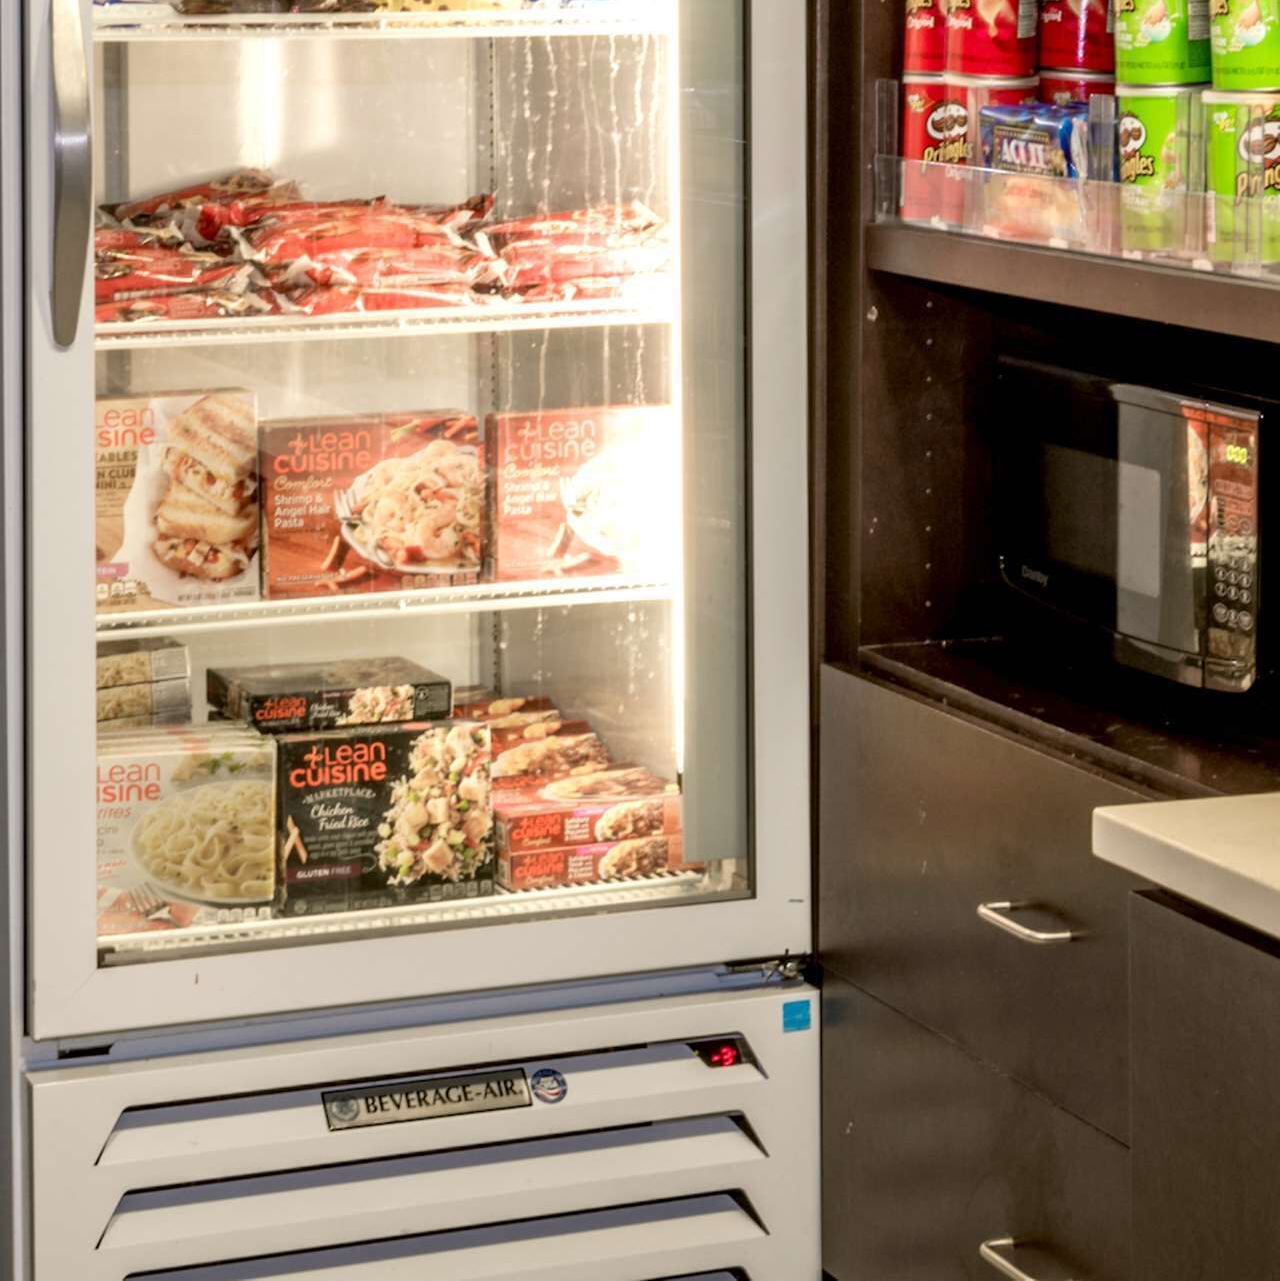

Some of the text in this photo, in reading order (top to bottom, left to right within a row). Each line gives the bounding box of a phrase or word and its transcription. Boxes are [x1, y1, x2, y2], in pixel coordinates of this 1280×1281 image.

[97, 427, 156, 448] sine
[310, 430, 370, 452] Lean
[273, 449, 370, 474] cuisine
[273, 475, 334, 493] Comfort
[273, 494, 313, 506] Shrimp
[273, 505, 307, 517] Angel
[273, 517, 305, 529] Pasta
[272, 696, 307, 709] Lean
[255, 707, 306, 721] cuisine
[325, 741, 386, 765] Lean
[289, 761, 388, 788] cuisine
[97, 781, 162, 803] isine
[310, 802, 355, 819] Chicken
[318, 815, 370, 832] Fried Rice
[296, 868, 330, 879] GLUTEN
[364, 1079, 518, 1114] BEVERAGE-AIR
